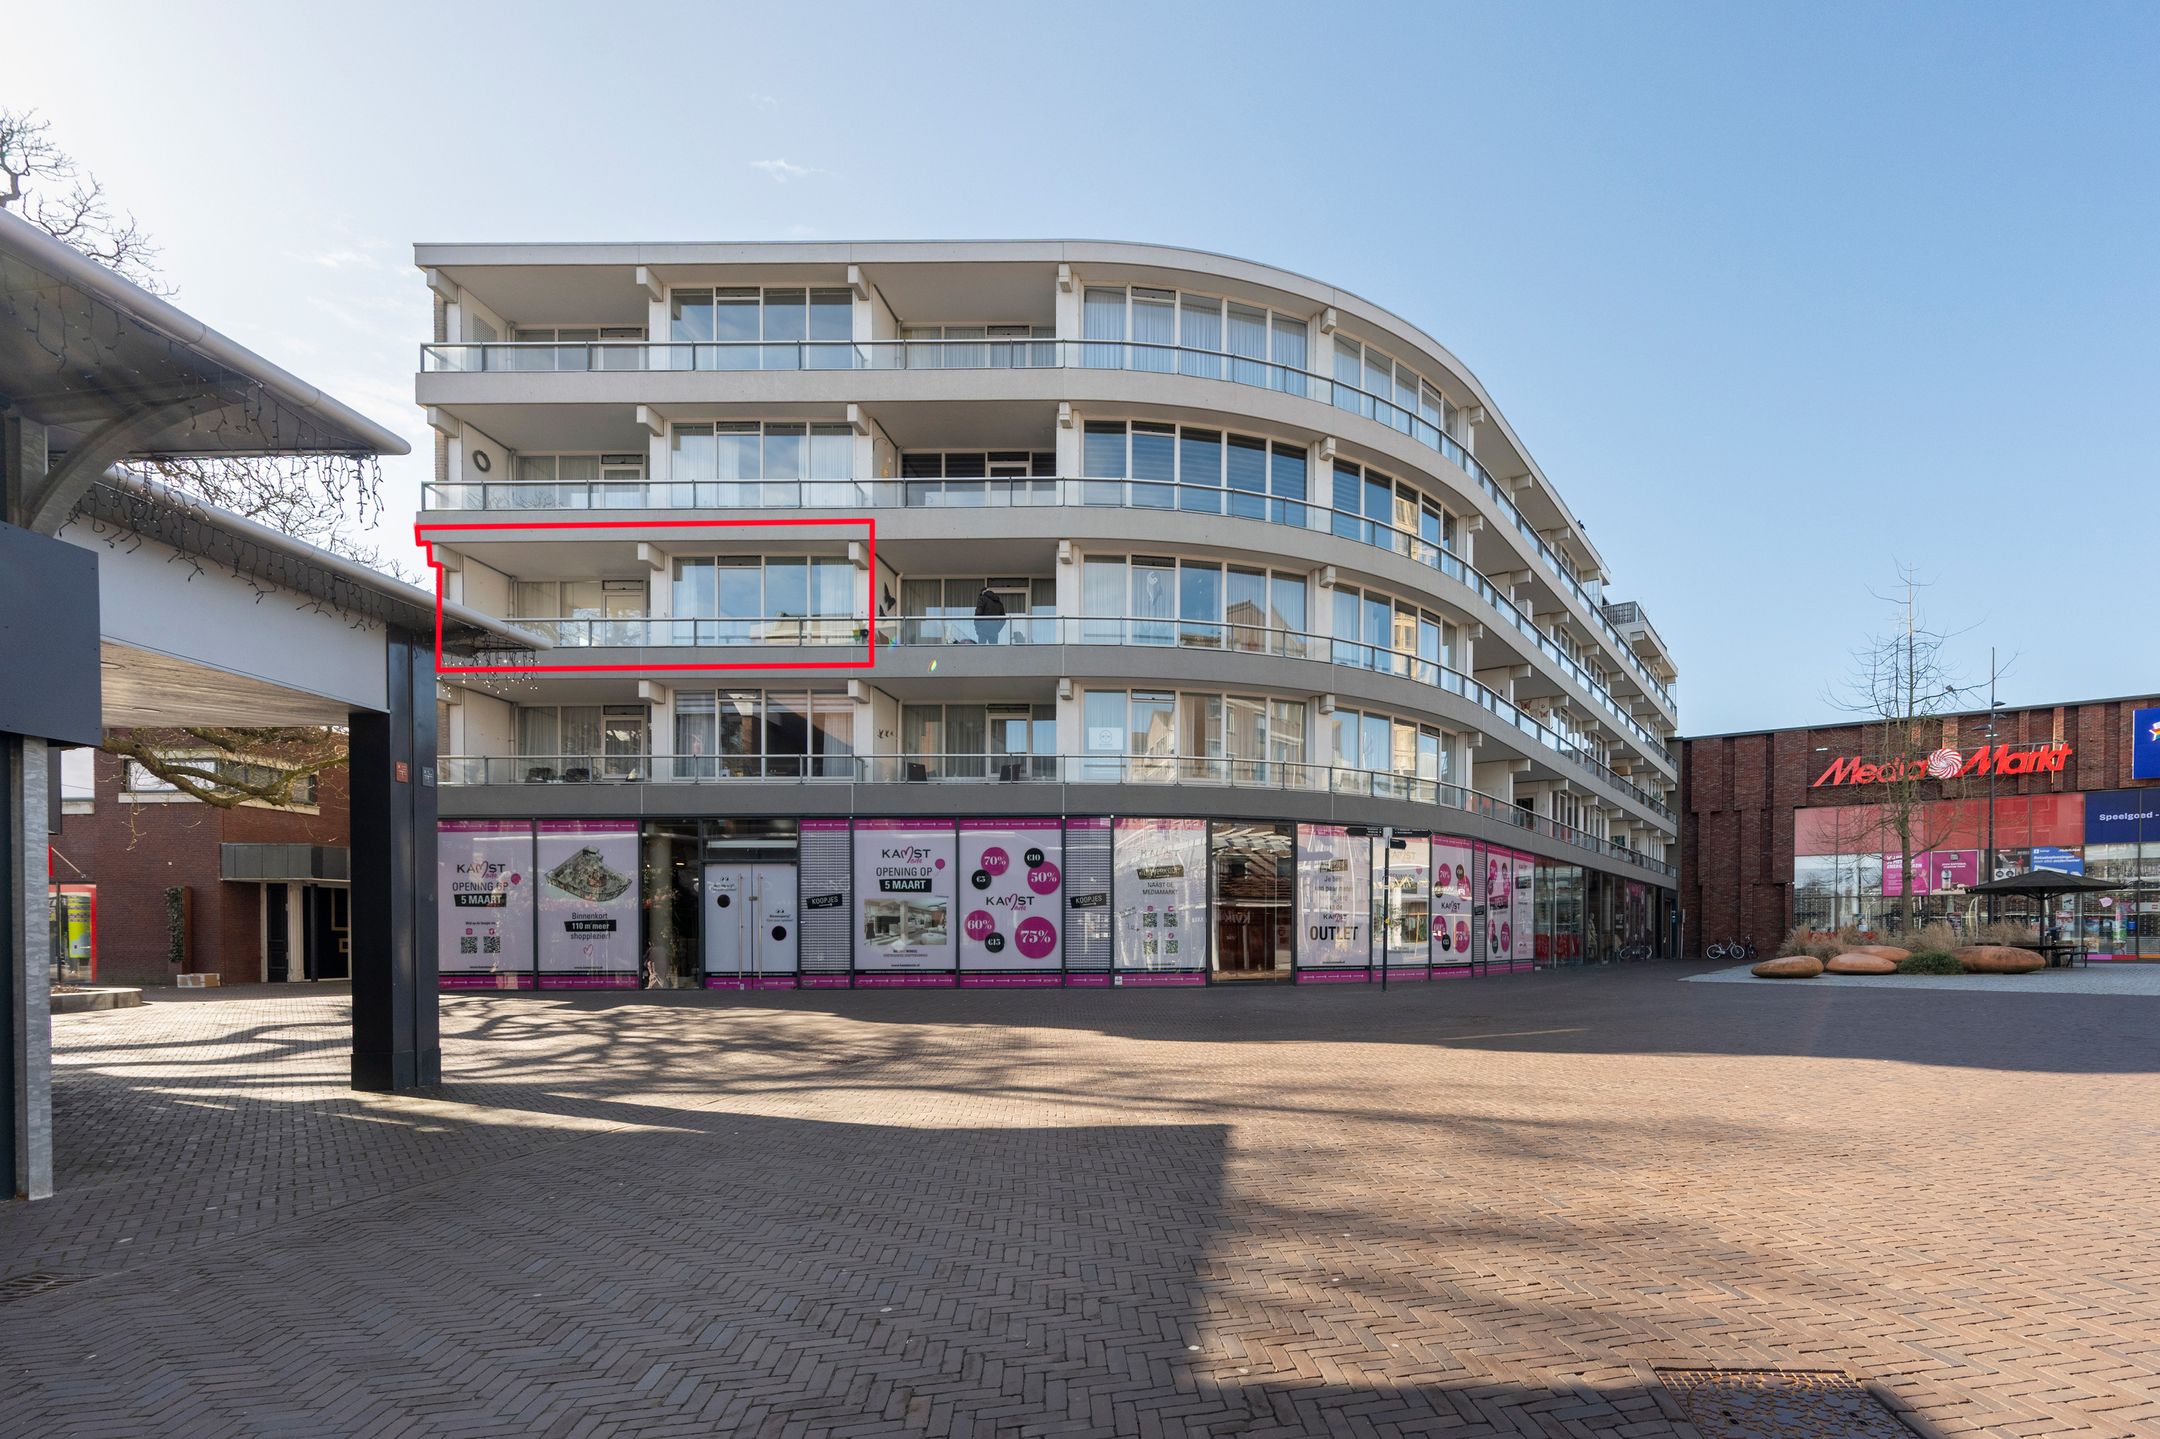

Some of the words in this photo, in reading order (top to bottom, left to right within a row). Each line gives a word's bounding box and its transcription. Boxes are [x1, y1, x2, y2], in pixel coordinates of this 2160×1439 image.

[1812, 752, 1929, 787] Media
[1953, 743, 2073, 778] Markt
[2099, 811, 2153, 822] Speelgoed
[984, 856, 1006, 866] 70%
[876, 867, 917, 877] OPENING
[920, 867, 933, 877] OP
[1031, 871, 1057, 883] 50%
[452, 882, 493, 892] OPENING
[885, 881, 890, 889] 5
[892, 880, 926, 890] MAART
[461, 896, 467, 904] 5
[468, 895, 502, 904] MAART
[811, 896, 839, 904] KOOPJES
[986, 893, 1035, 911] KAMST
[1075, 894, 1103, 904] KOOPJES
[572, 912, 608, 920] Binnenkort
[967, 919, 992, 930] 60%
[1020, 930, 1051, 944] 75%
[1310, 926, 1359, 941] OUTLET
[988, 938, 1001, 946] €15
